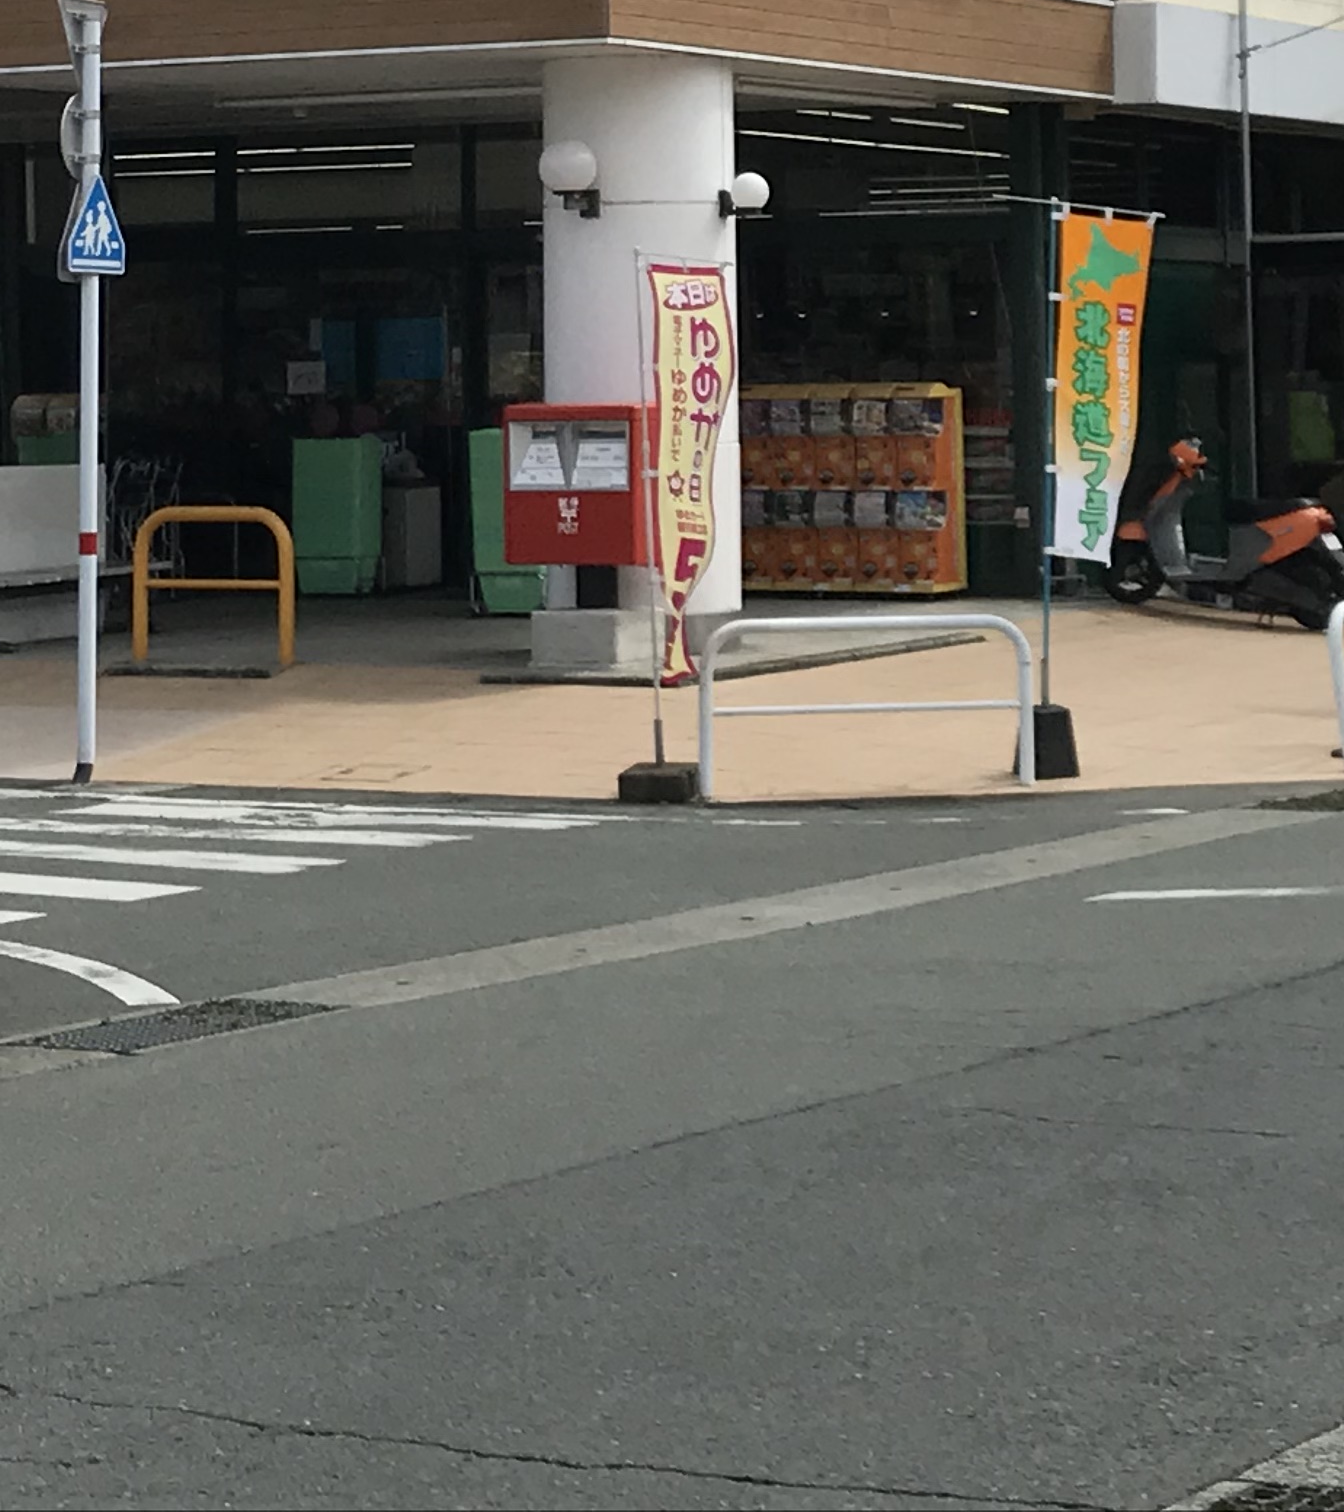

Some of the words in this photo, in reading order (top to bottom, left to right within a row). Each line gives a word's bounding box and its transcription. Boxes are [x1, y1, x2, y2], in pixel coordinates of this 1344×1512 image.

[1071, 300, 1114, 553] 北海道フェア
